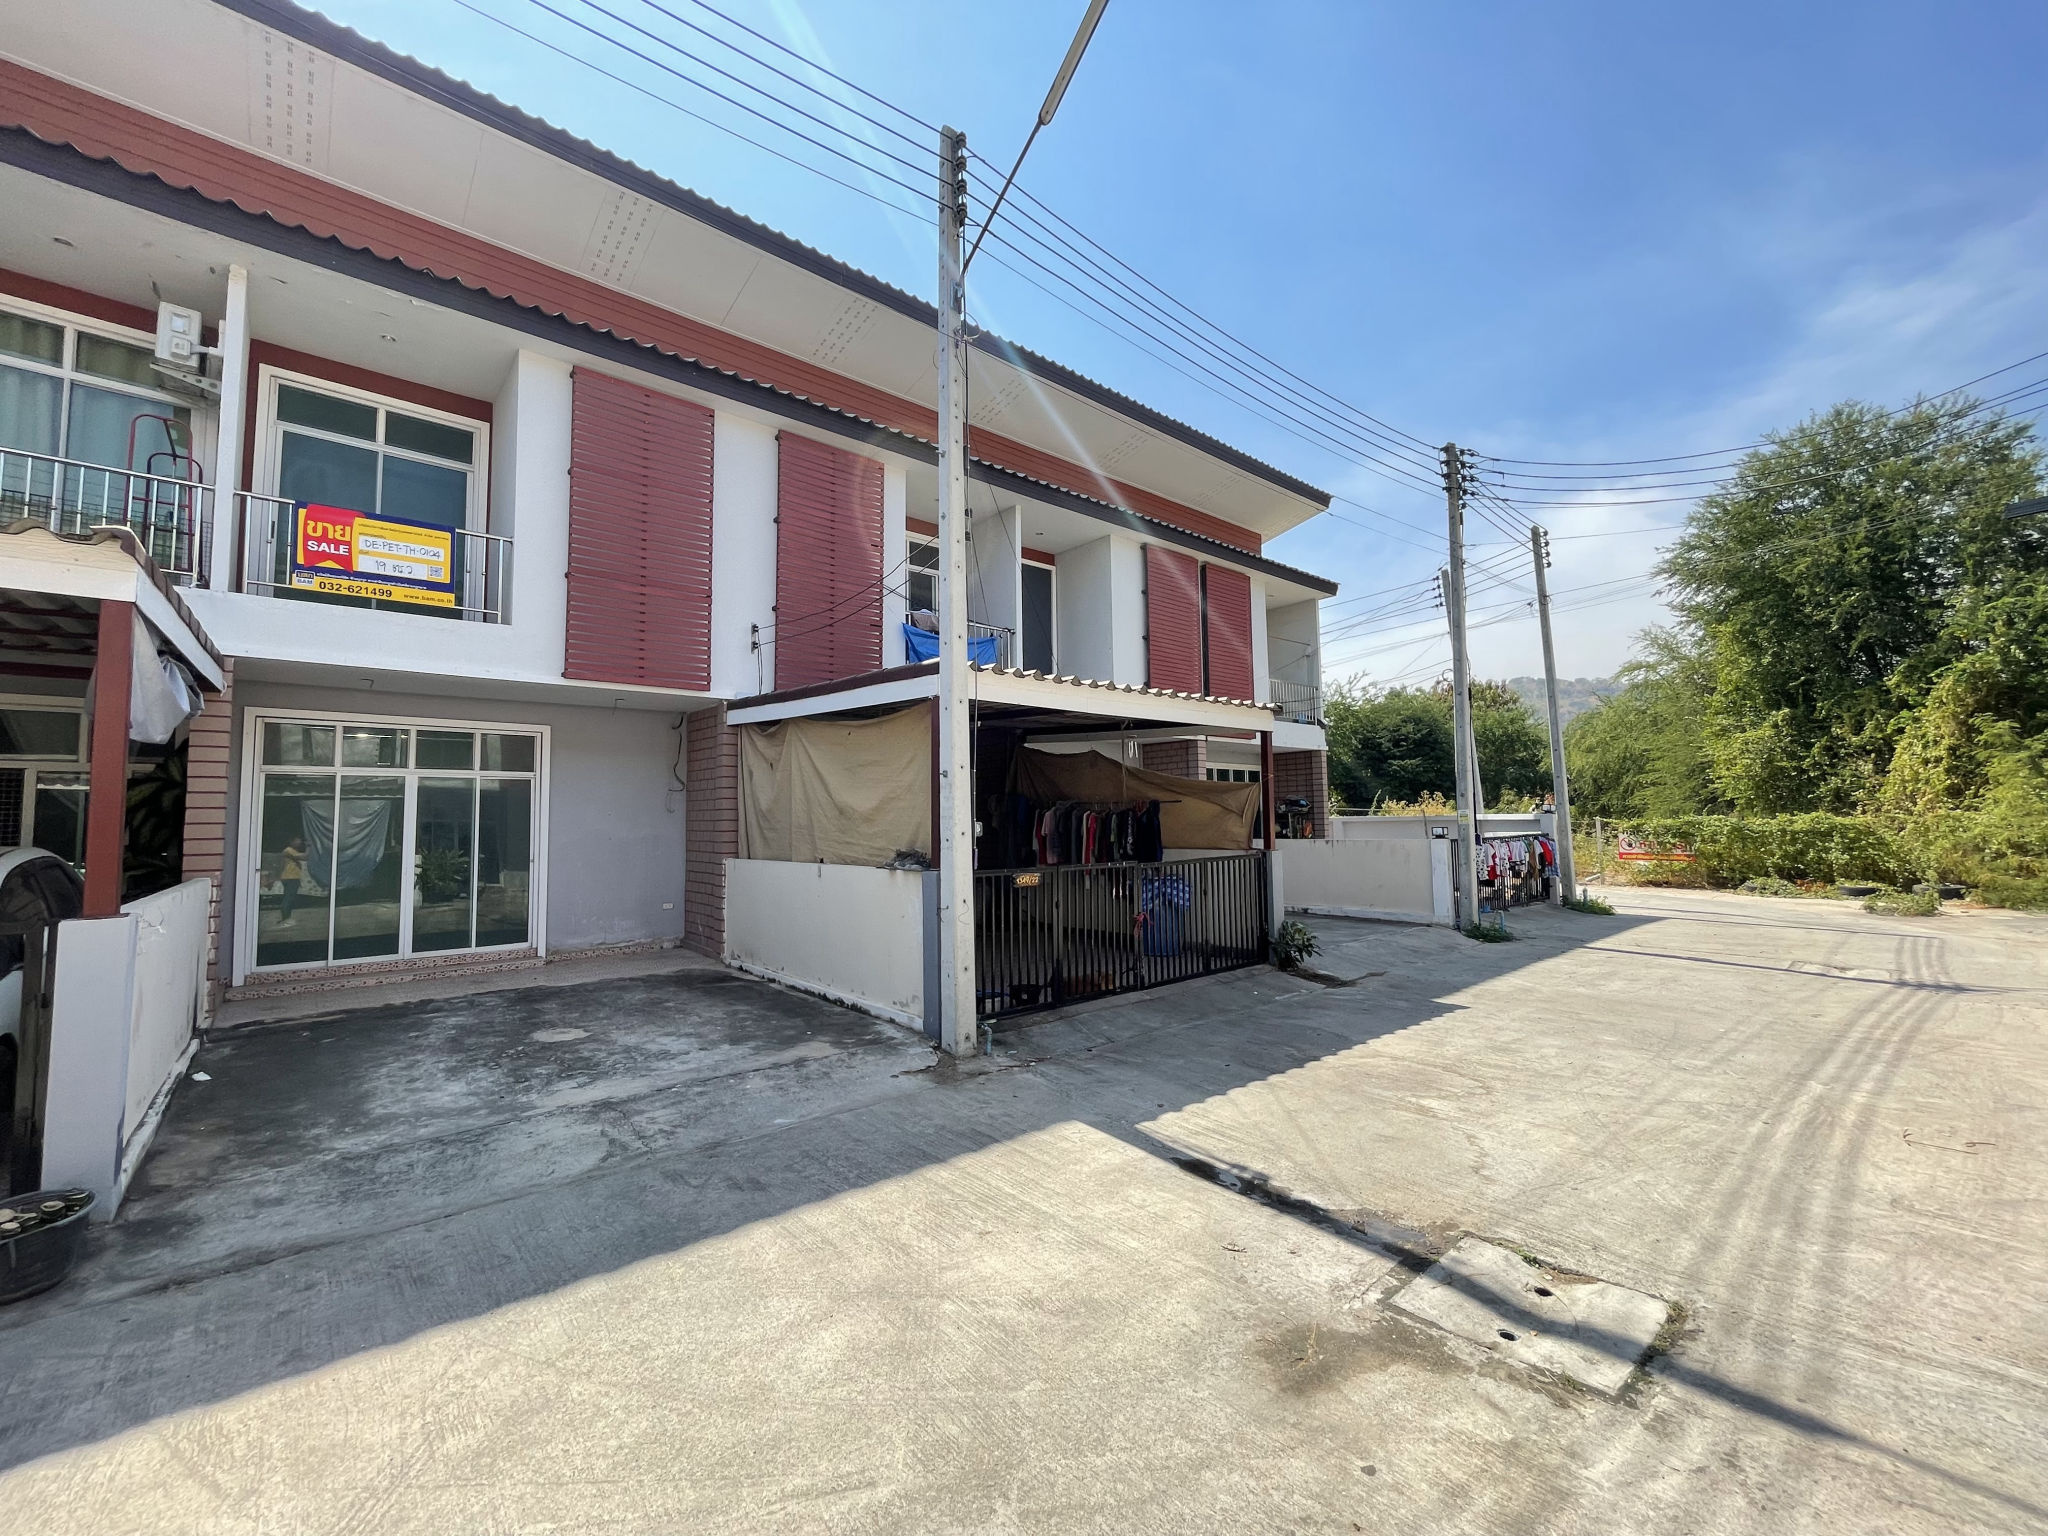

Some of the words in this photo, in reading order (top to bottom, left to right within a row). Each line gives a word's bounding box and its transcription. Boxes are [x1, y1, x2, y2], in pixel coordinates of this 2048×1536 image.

[307, 520, 351, 541] ขาย
[307, 540, 349, 556] SALE
[319, 581, 392, 598] 032-621499
[404, 594, 453, 604] www.bam.co.th
